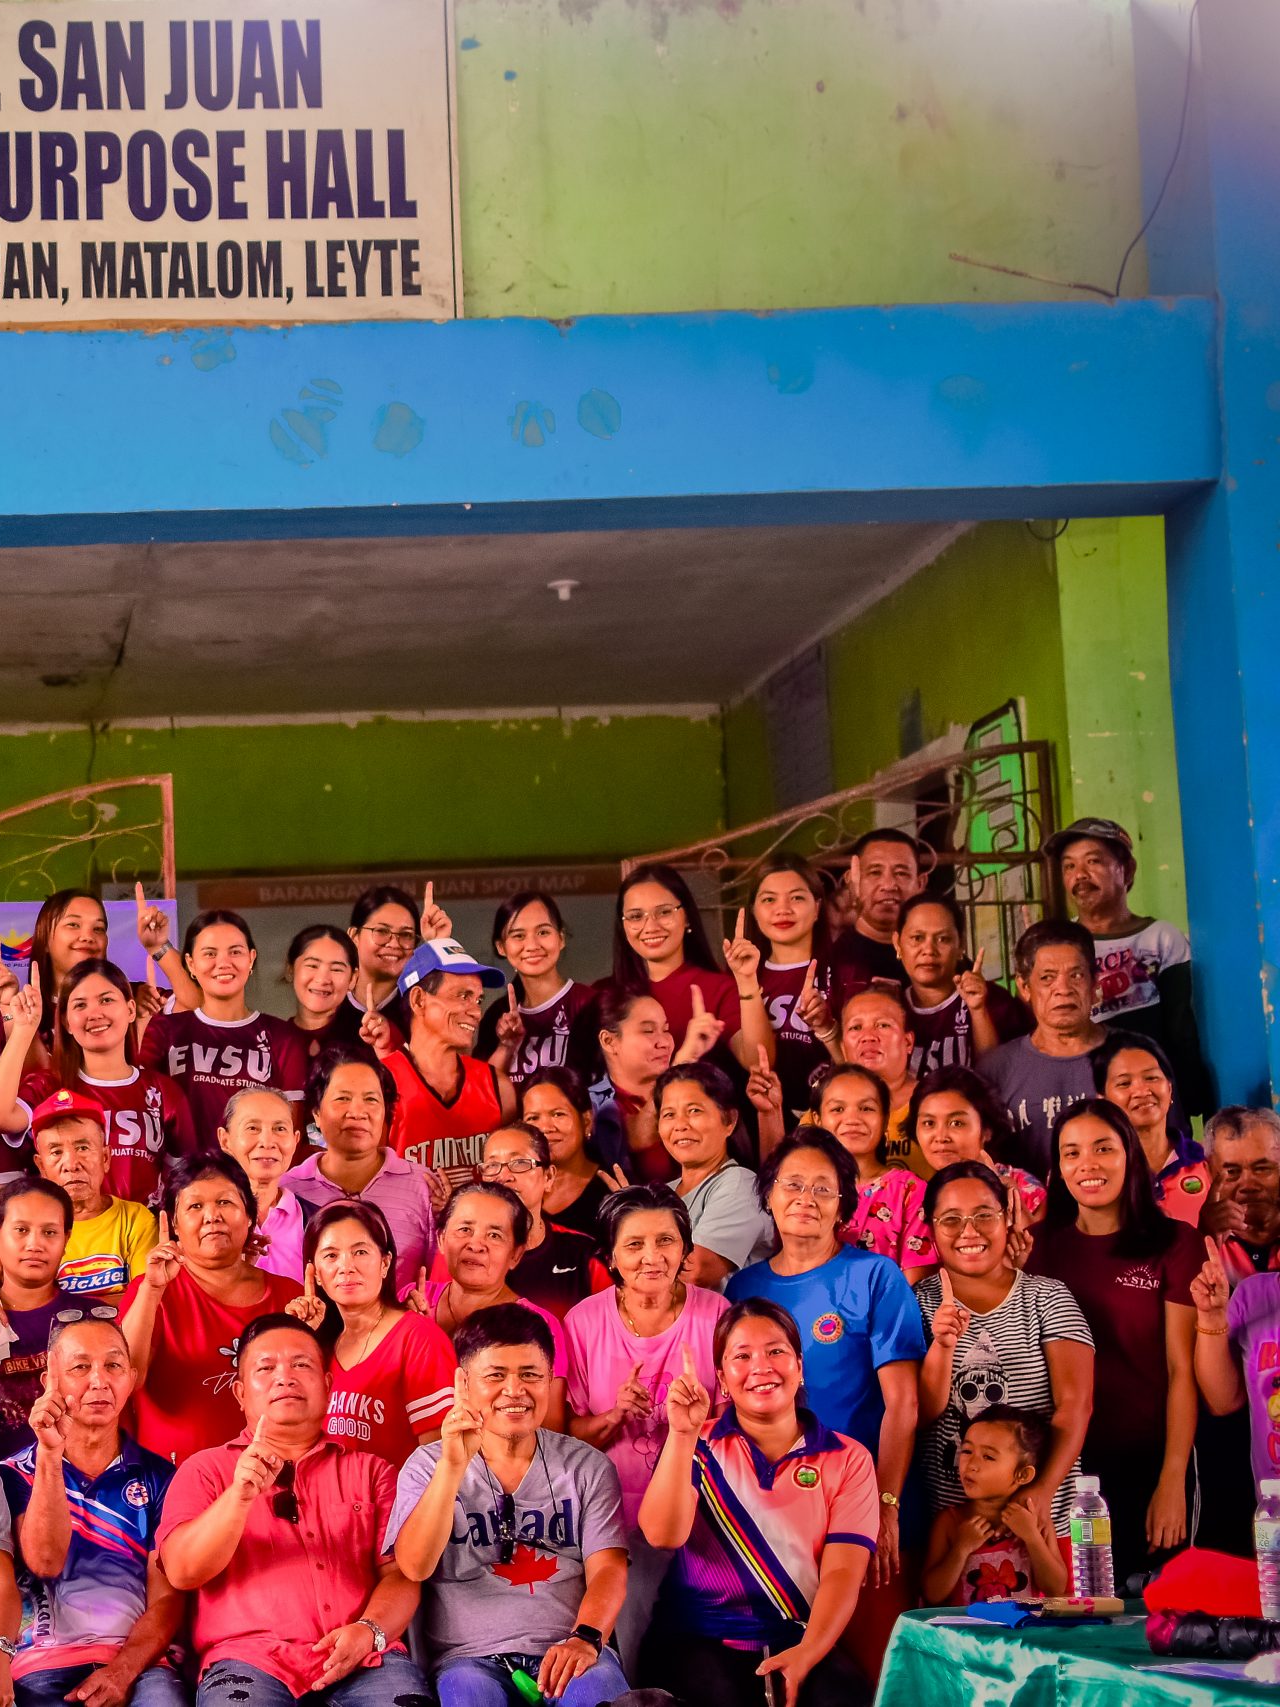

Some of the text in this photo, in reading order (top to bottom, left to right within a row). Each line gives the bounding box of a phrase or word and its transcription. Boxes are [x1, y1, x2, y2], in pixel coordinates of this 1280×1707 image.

[18, 19, 146, 112] SAN
[164, 19, 323, 112] JUAN
[266, 128, 418, 219] HALL
[81, 240, 294, 304] MATALOM,
[305, 239, 422, 298] LEYTE
[259, 882, 370, 902] BARANGAY
[482, 877, 533, 895] SPOT
[538, 875, 585, 891] MAP
[168, 1042, 272, 1083] EVSU
[193, 1075, 234, 1087] GRADUATE
[327, 1391, 385, 1425] HANKS
[327, 1417, 371, 1441] GOOD
